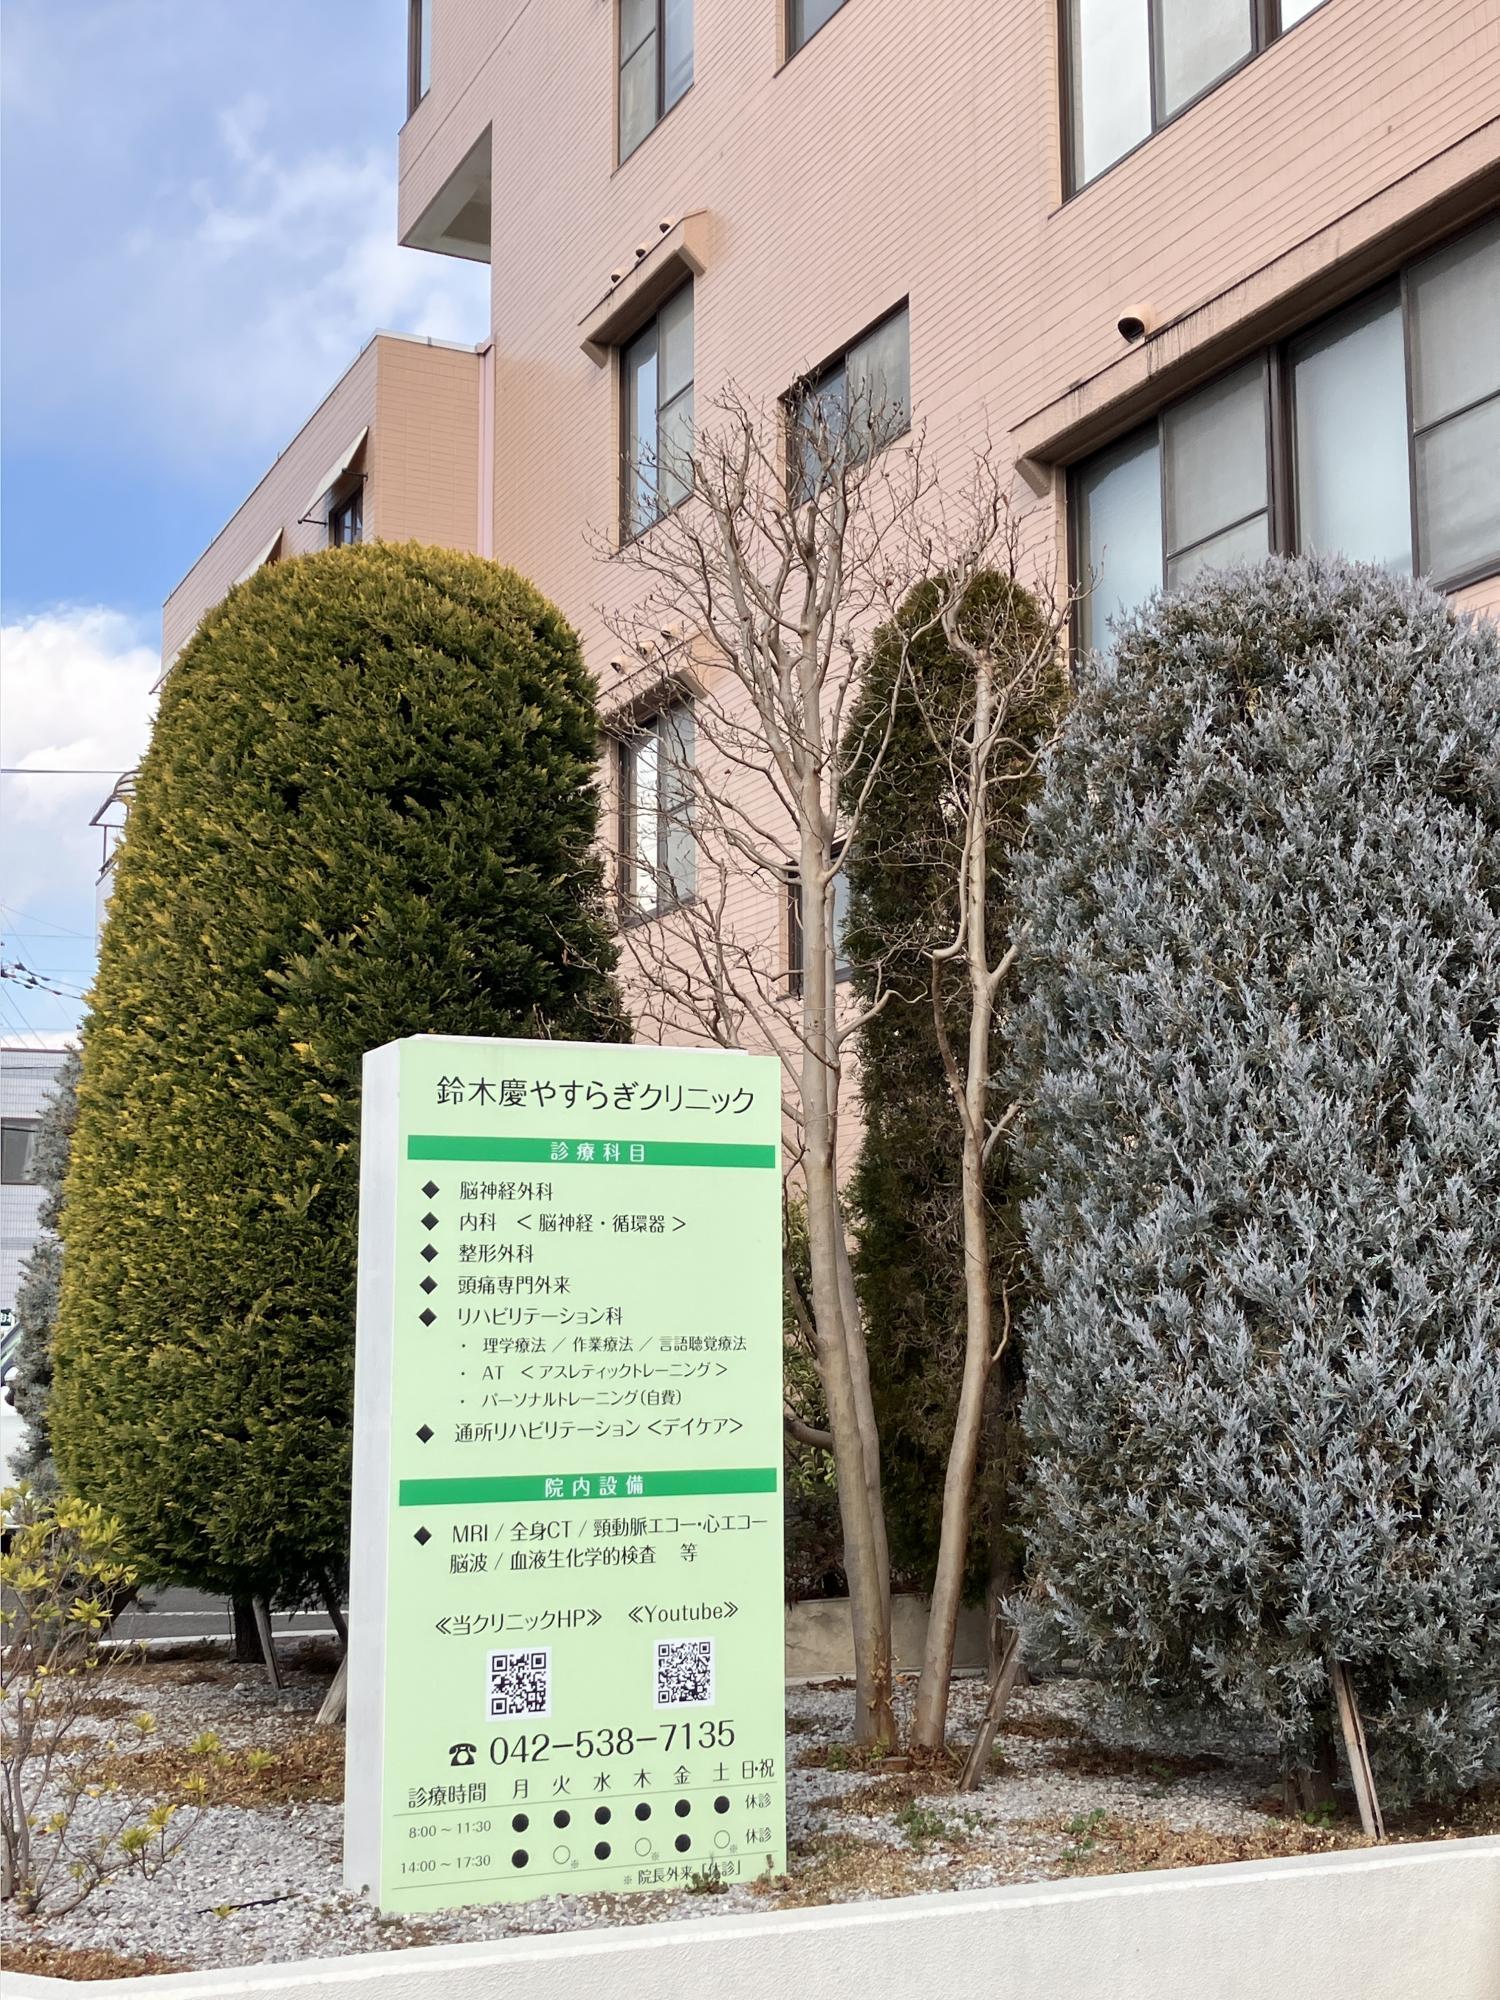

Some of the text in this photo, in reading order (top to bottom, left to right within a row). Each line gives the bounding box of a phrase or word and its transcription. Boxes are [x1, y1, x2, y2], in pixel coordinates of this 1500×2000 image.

[436, 1075, 754, 1115] 鈴木慶やすらぎクリニック
[551, 1142, 645, 1162] 診療科目
[459, 1180, 554, 1202] 脳神経外科
[459, 1211, 497, 1232] 内科
[458, 1243, 535, 1264] 整形外科
[457, 1274, 571, 1296] 頭痛専門外来
[458, 1306, 624, 1327] リハビリテーション科
[481, 1364, 505, 1381] AT
[545, 1476, 644, 1498] 院内設備
[452, 1523, 489, 1544] MRI
[510, 1520, 573, 1542] 全身CT
[448, 1552, 489, 1575] 脳波
[509, 1544, 657, 1571] 血液生化学的検査
[680, 1542, 698, 1563] 等
[489, 1719, 735, 1765] 042-538-7135
[408, 1782, 486, 1808] 診療時間
[512, 1778, 529, 1800] 月
[552, 1774, 571, 1797] 火
[593, 1771, 612, 1793] 水
[633, 1767, 652, 1789] 木
[672, 1764, 692, 1786] 金
[712, 1761, 730, 1783] 土
[744, 1792, 772, 1810] 休診
[408, 1824, 437, 1839] 8:00
[456, 1819, 492, 1835] 11:30
[745, 1826, 772, 1845] 休診
[400, 1859, 437, 1875] 14:00
[456, 1854, 491, 1870] 17:30
